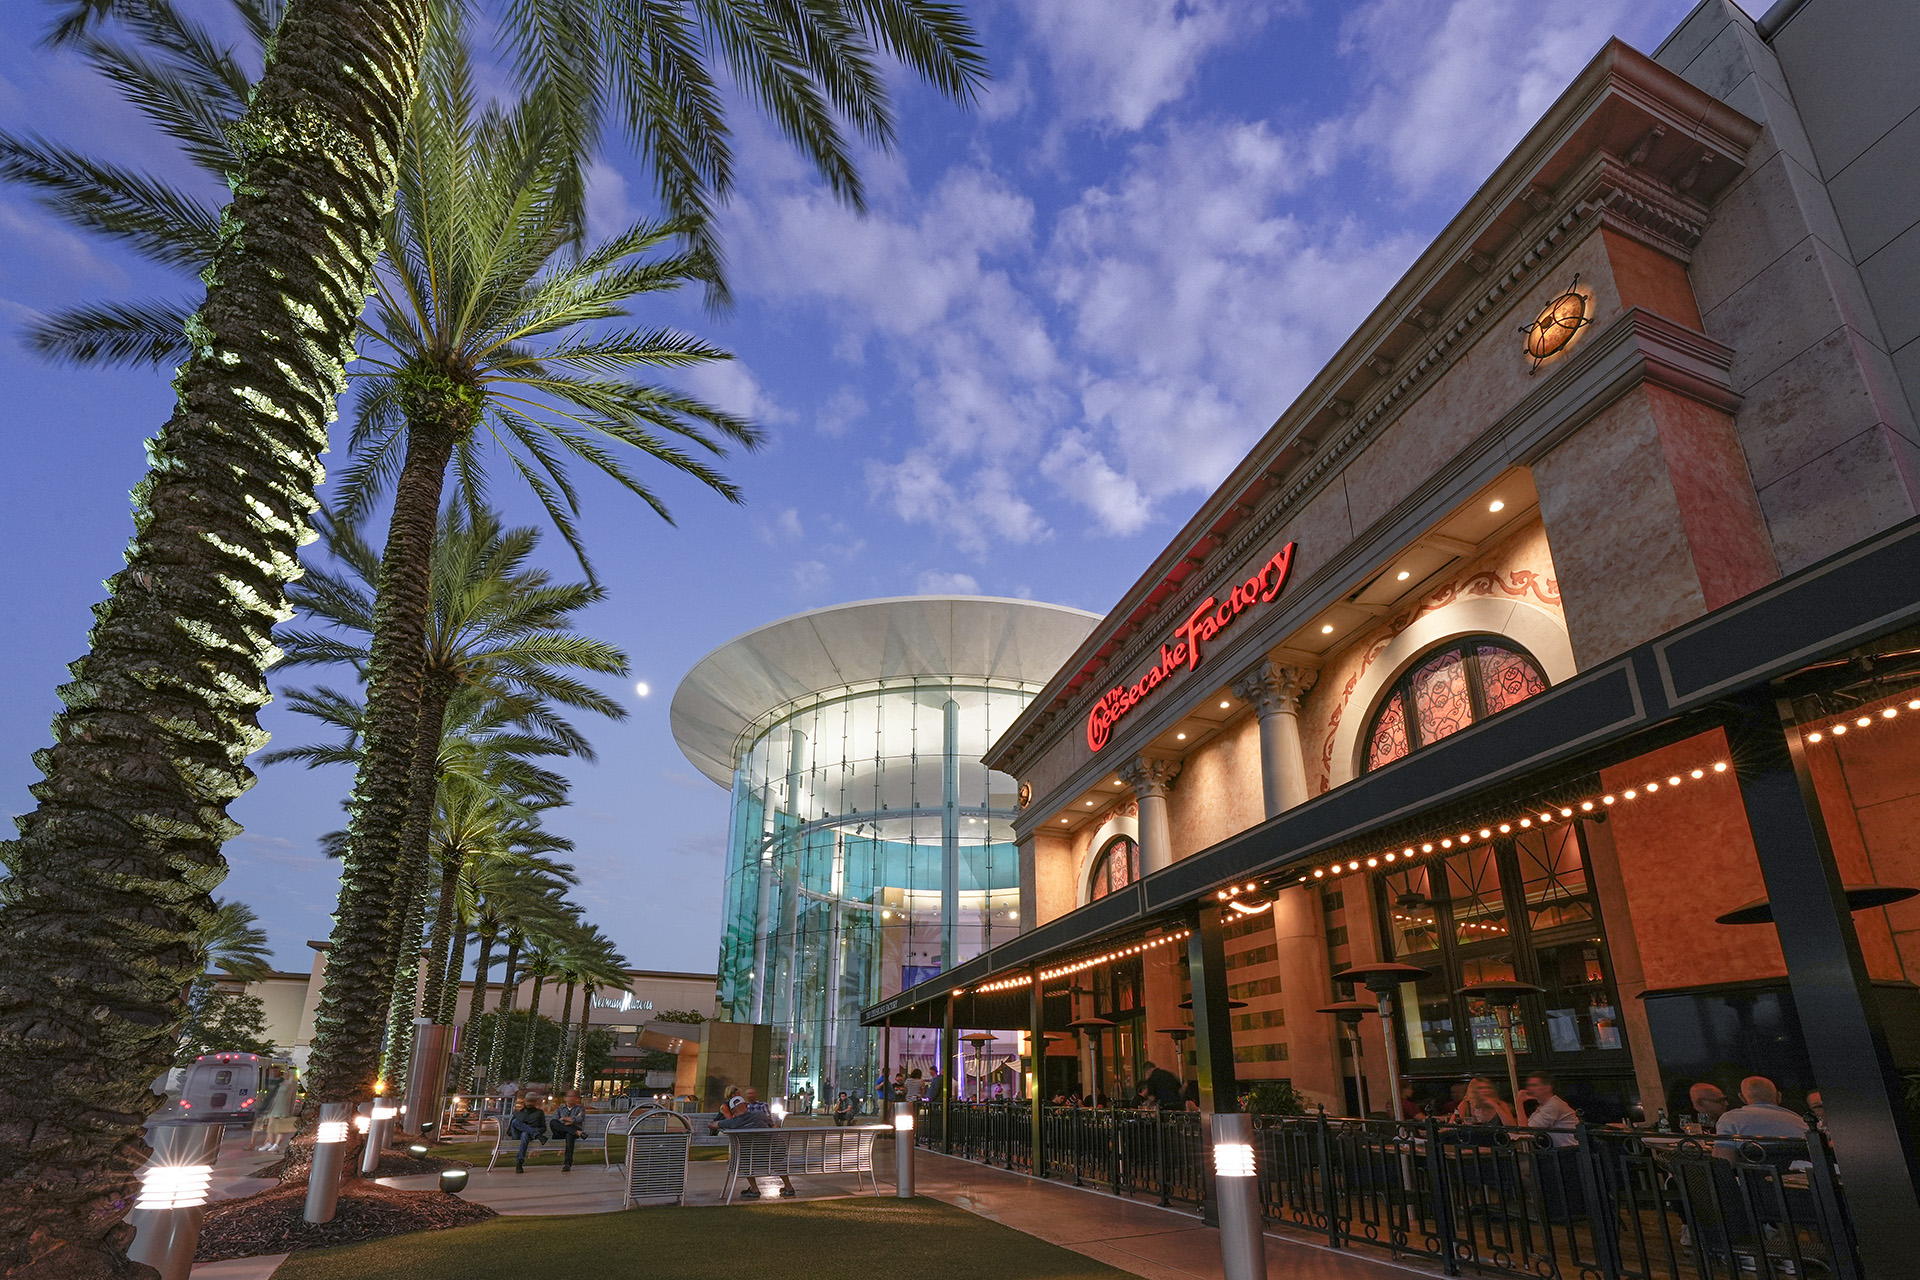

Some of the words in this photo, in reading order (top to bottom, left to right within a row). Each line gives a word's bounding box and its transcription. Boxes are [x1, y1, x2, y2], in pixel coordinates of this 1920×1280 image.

[1174, 541, 1294, 672] Factory
[1087, 643, 1187, 752] Cheesecake
[1106, 685, 1123, 705] The
[589, 989, 622, 1010] Neiman
[620, 990, 653, 1013] Marcus
